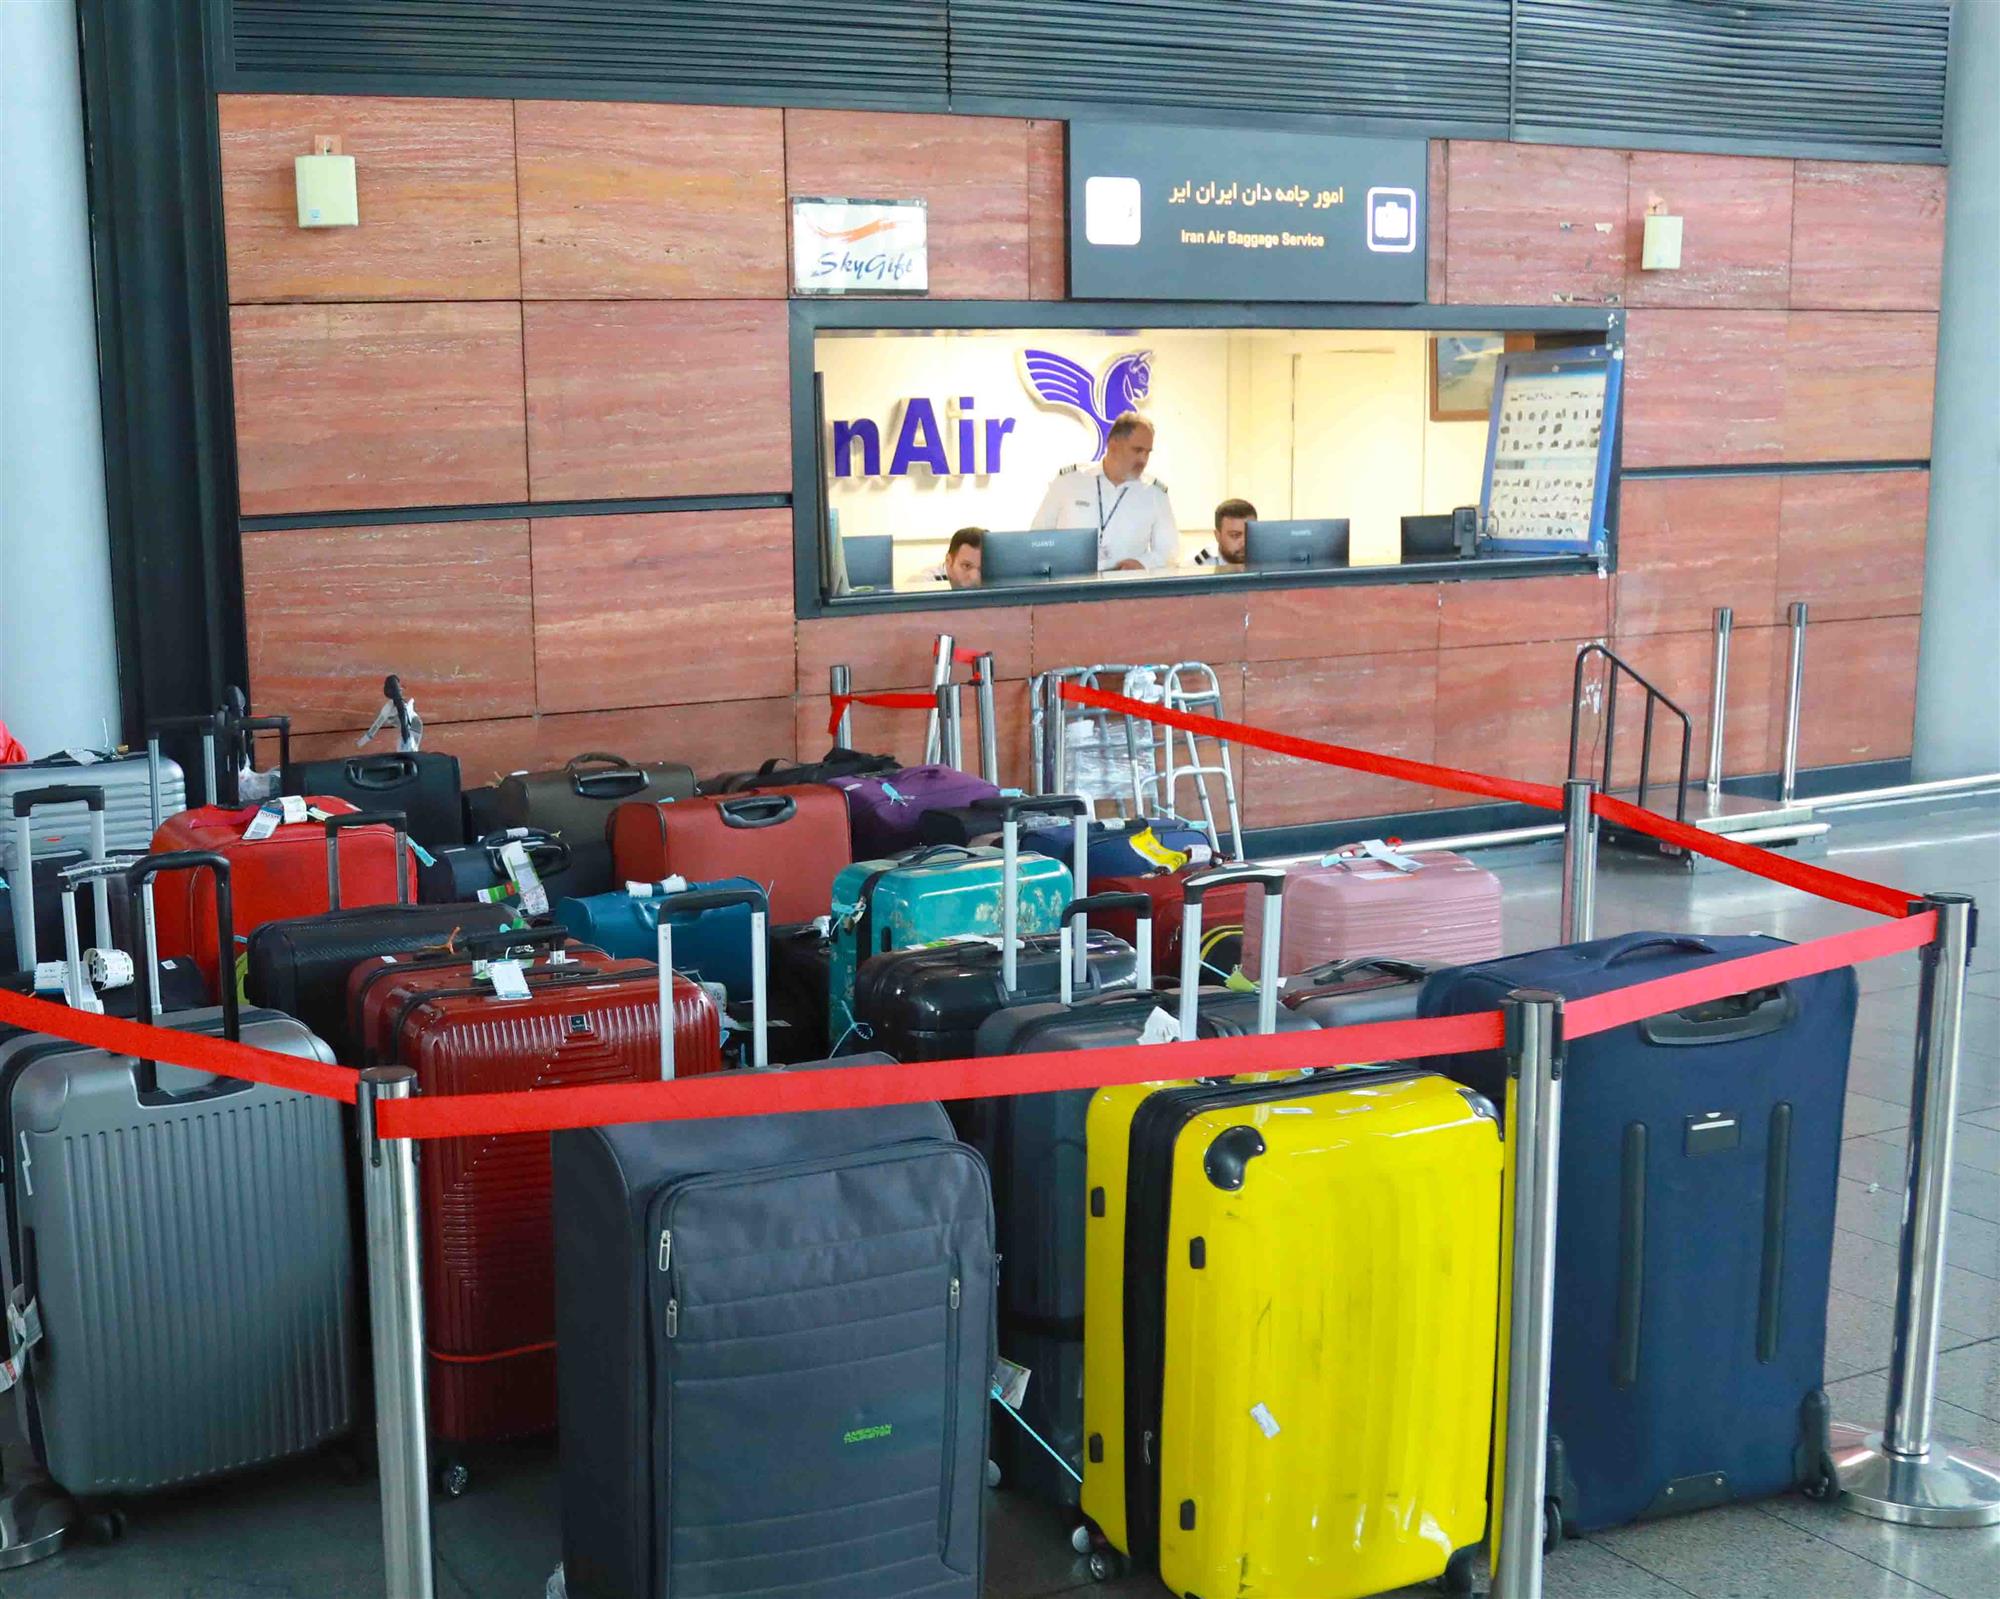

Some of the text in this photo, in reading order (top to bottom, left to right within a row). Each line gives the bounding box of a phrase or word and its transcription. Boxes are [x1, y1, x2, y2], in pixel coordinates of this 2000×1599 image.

[1195, 181, 1237, 206] ایران
[1242, 183, 1272, 206] دان
[1275, 185, 1310, 207] جامه
[1313, 186, 1344, 208] امور
[1181, 229, 1325, 248] Iran Air Baggage Service
